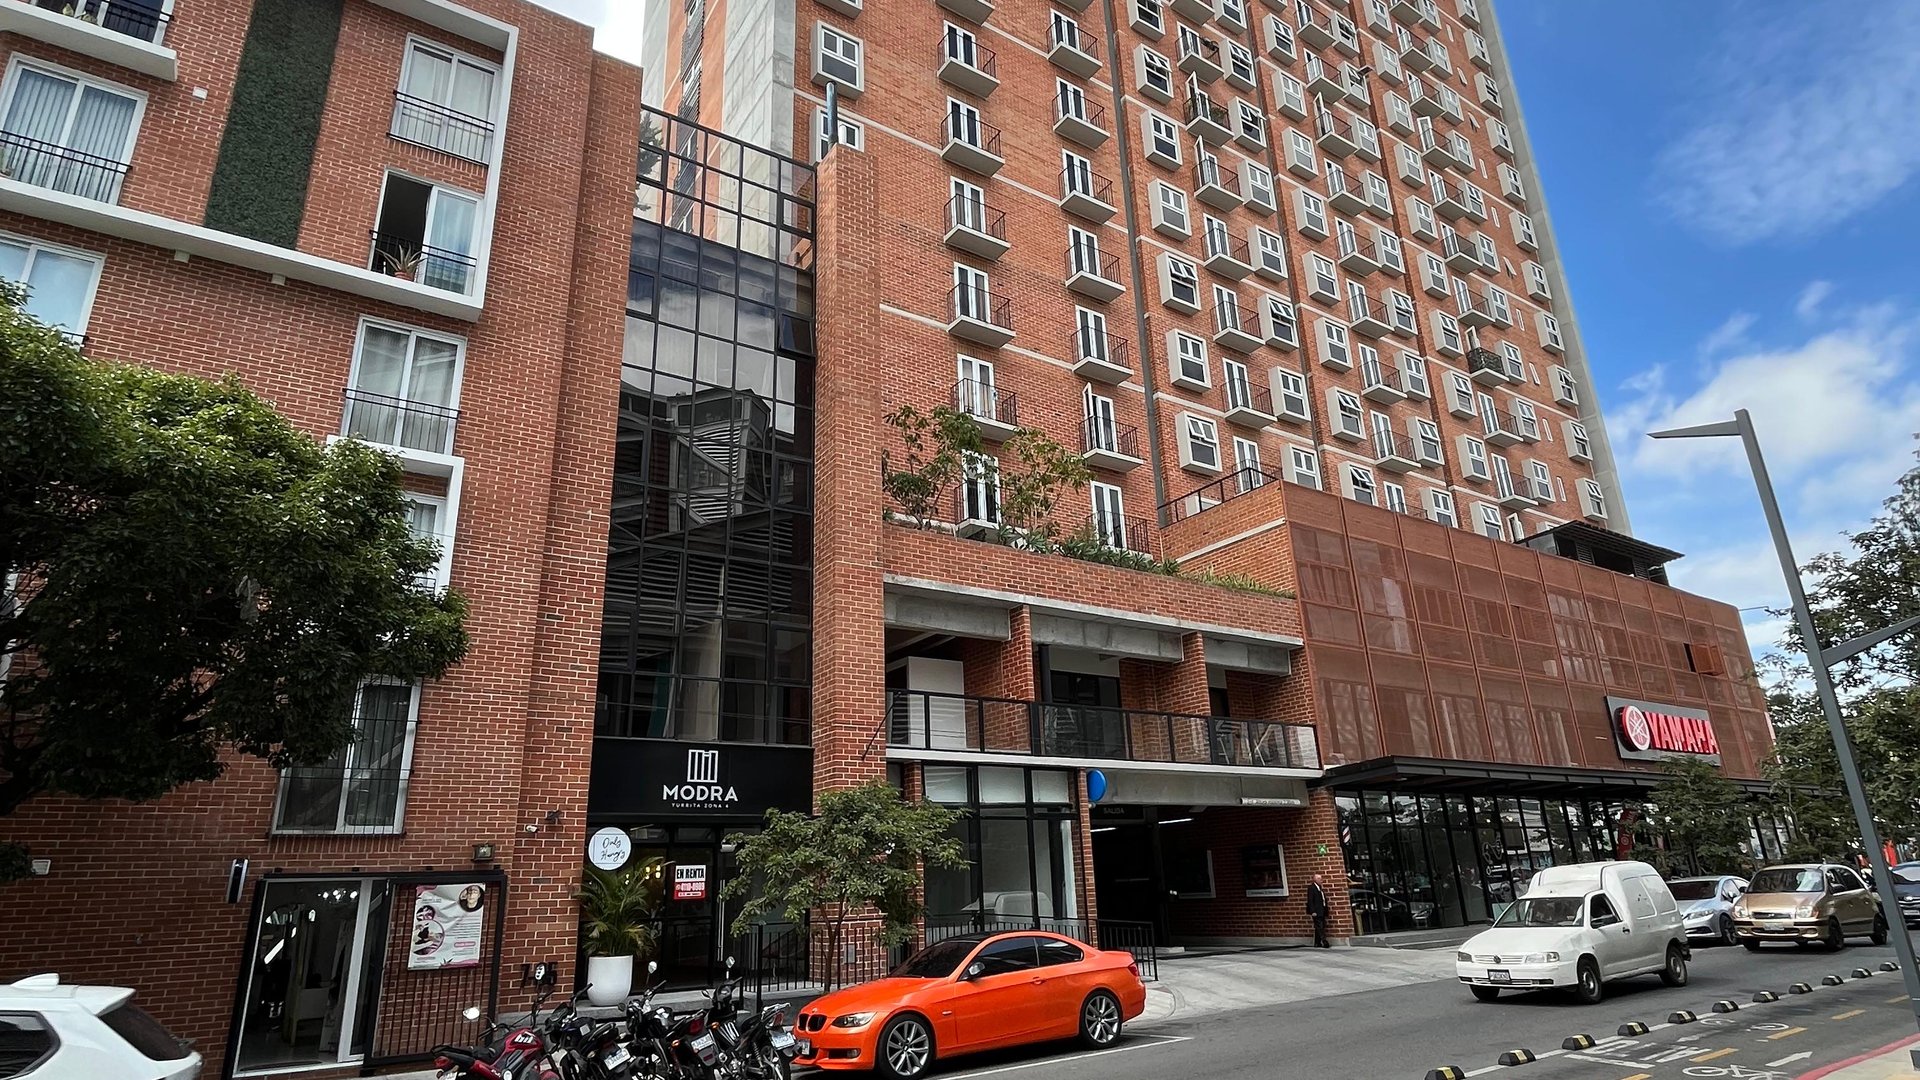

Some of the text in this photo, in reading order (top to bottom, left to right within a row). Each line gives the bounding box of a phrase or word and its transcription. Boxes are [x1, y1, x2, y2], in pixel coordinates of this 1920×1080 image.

[1643, 711, 1720, 755] YAMAHA
[662, 784, 739, 802] MODRA
[703, 802, 723, 810] ZONA
[676, 868, 705, 879] EN RENTA
